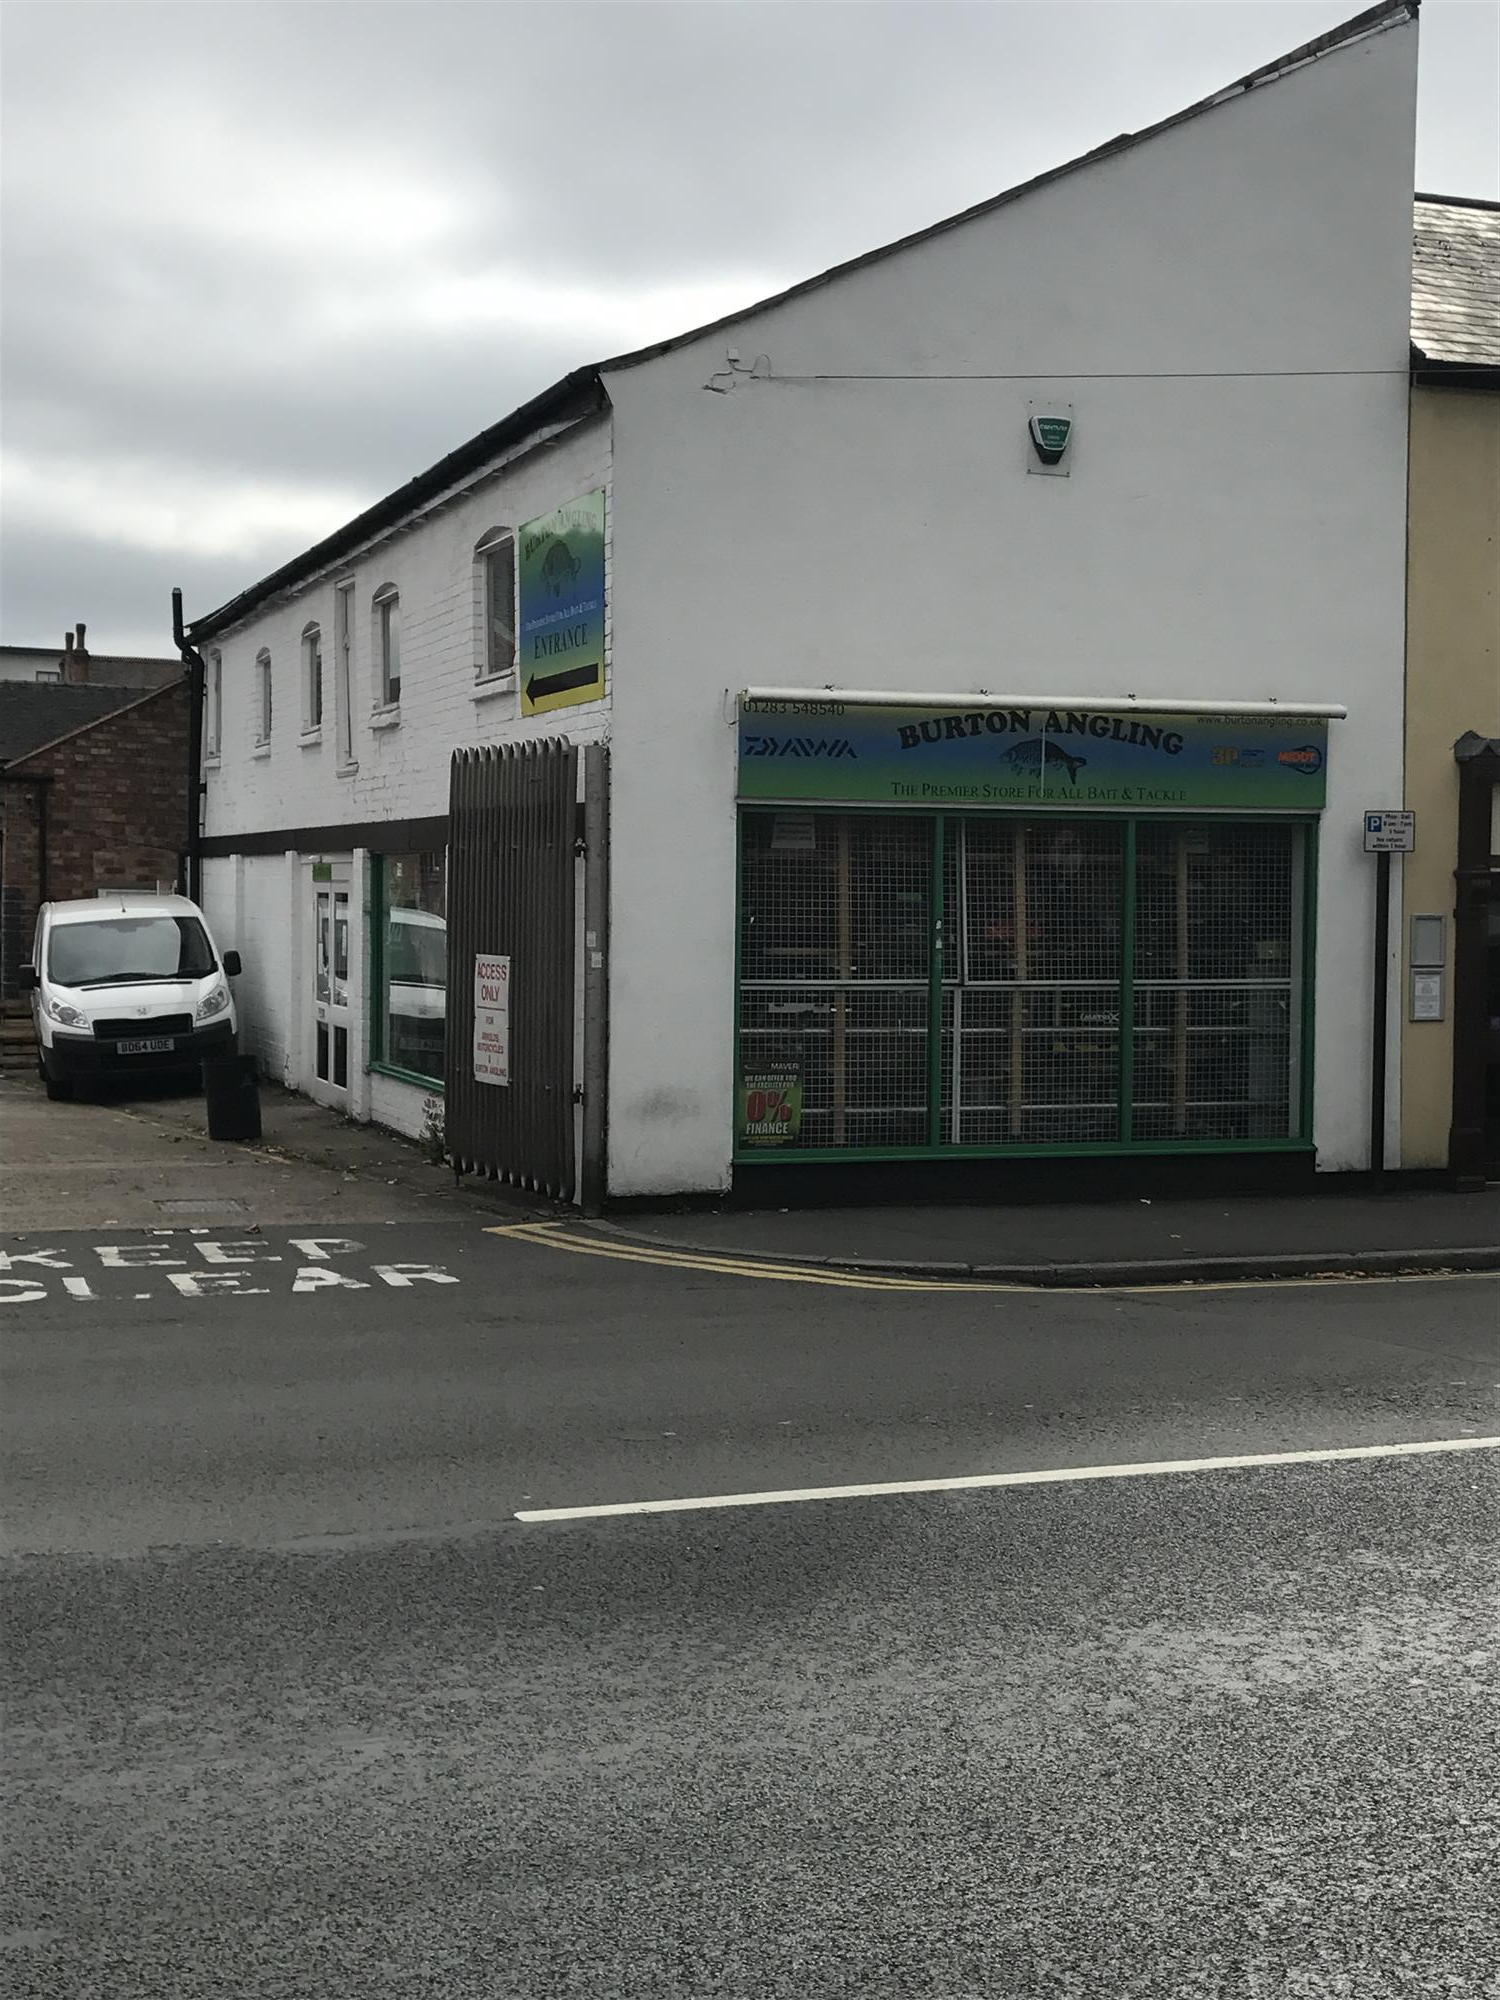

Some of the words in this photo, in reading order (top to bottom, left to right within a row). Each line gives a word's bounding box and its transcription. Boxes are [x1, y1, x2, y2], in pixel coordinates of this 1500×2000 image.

[534, 622, 588, 659] ENTRANCE
[743, 701, 787, 714] 01283
[792, 703, 845, 716] 548540
[1196, 717, 1323, 728] www.burtonangling.co.uk
[897, 711, 1032, 750] BURTON
[1040, 711, 1185, 755] ANGLING
[745, 735, 857, 758] DAIWA
[1121, 788, 1134, 800] &
[477, 962, 507, 981] ACCESS
[481, 984, 500, 1002] ONLY
[122, 1042, 147, 1052] BD64
[150, 1039, 170, 1050] UDE
[771, 1062, 800, 1070] MAVER
[747, 1088, 793, 1122] 0%
[746, 1122, 789, 1135] FINANCE
[0, 1238, 367, 1269] KEEP
